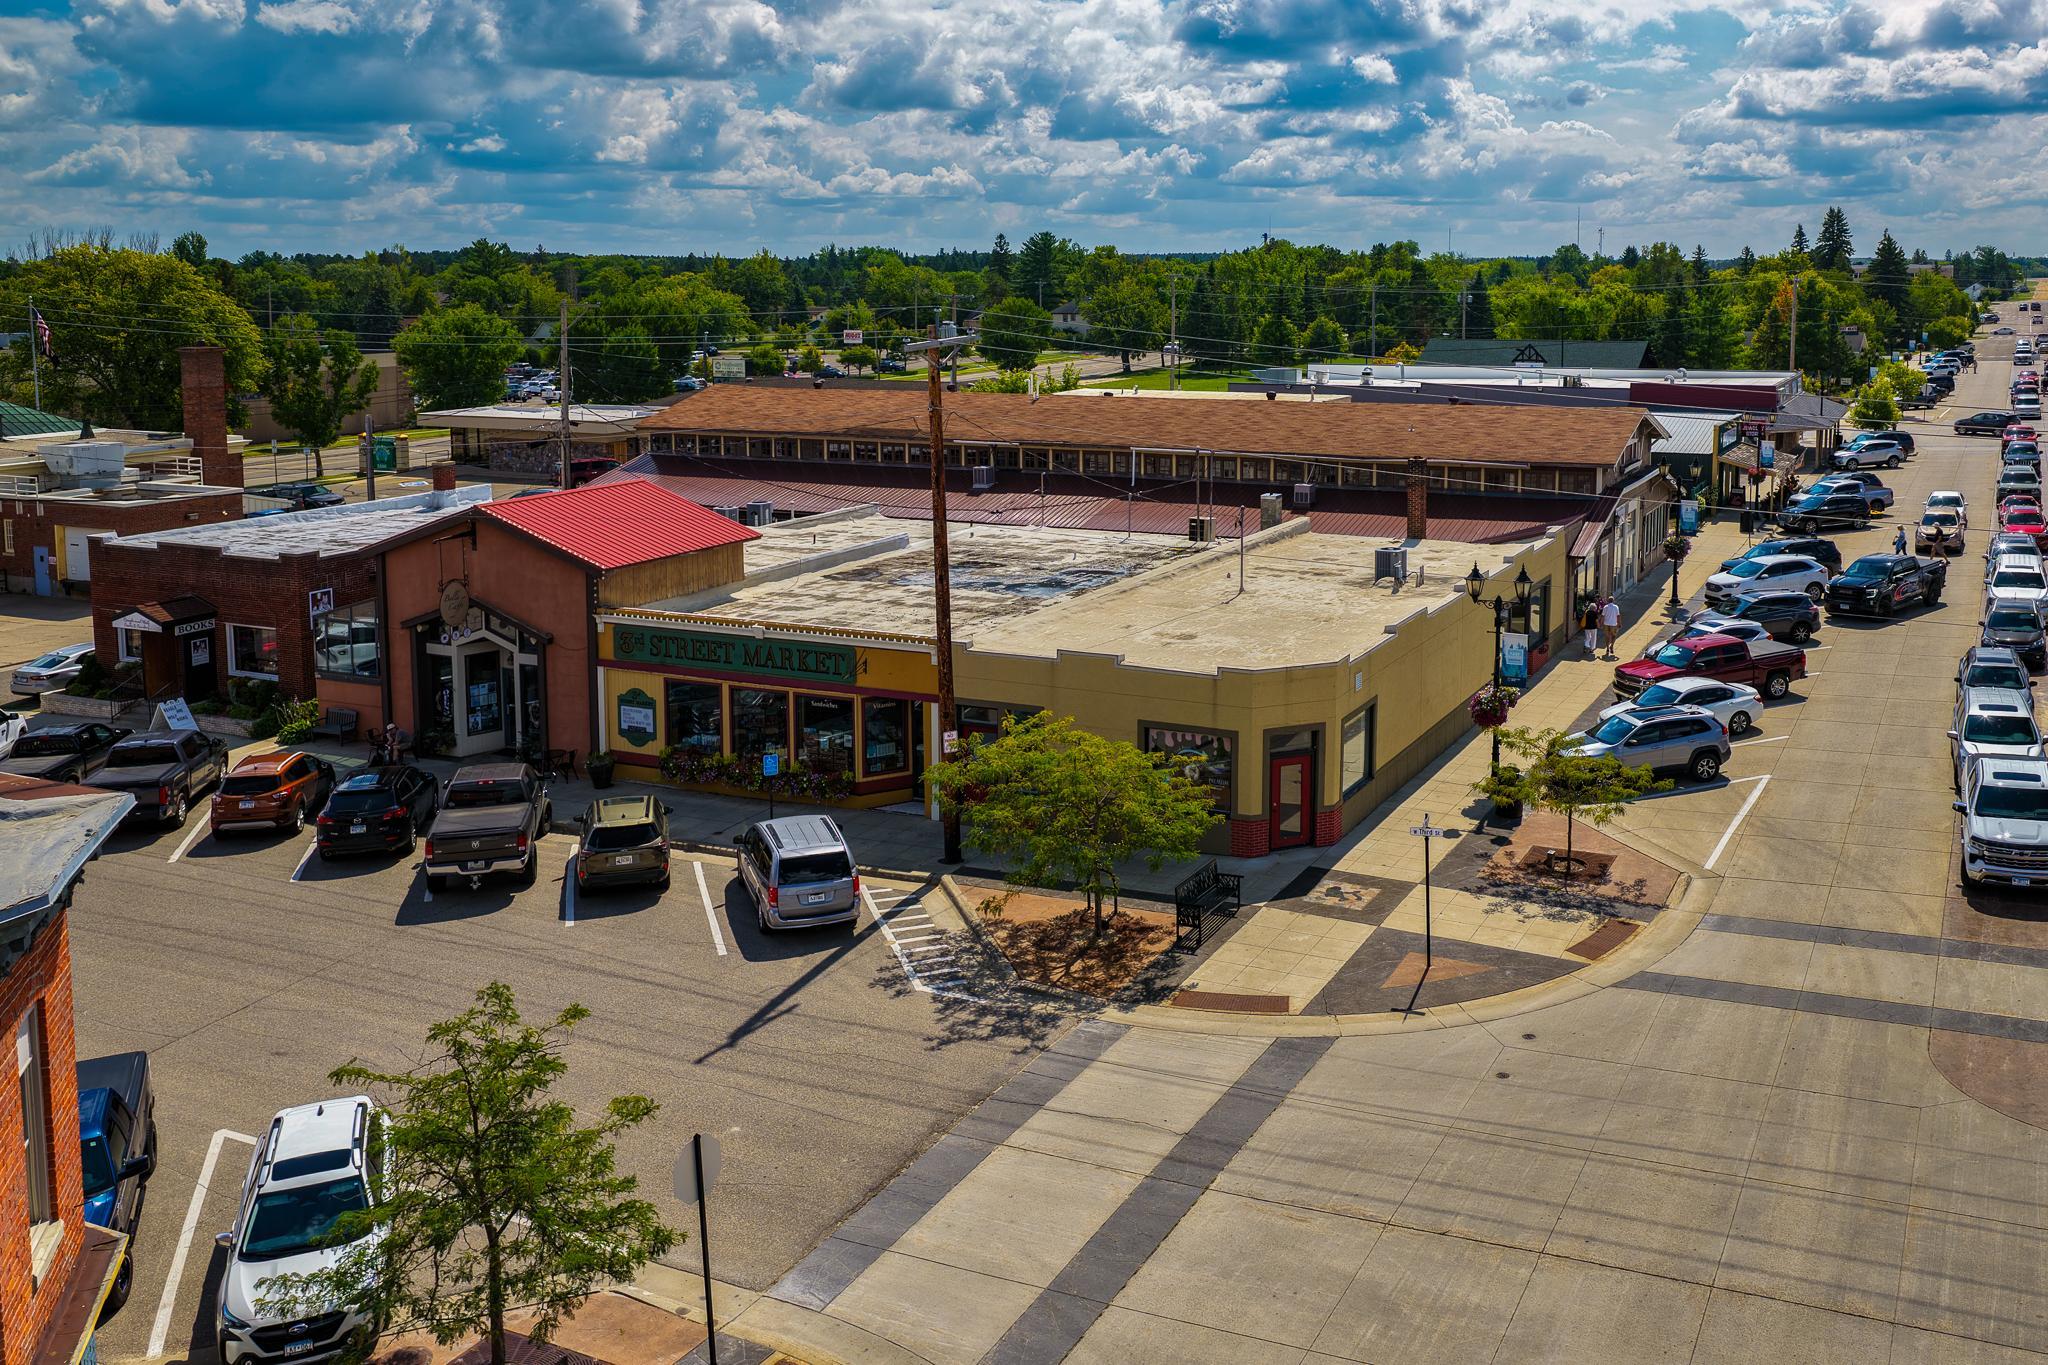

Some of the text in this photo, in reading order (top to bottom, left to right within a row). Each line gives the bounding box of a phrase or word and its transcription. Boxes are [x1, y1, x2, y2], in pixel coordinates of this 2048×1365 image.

[178, 619, 214, 634] BOOKS
[620, 631, 846, 676] 3rd STREET MARKET
[811, 699, 839, 709] Sandwiches
[872, 701, 897, 710] Vitamins
[1419, 828, 1433, 836] Third
